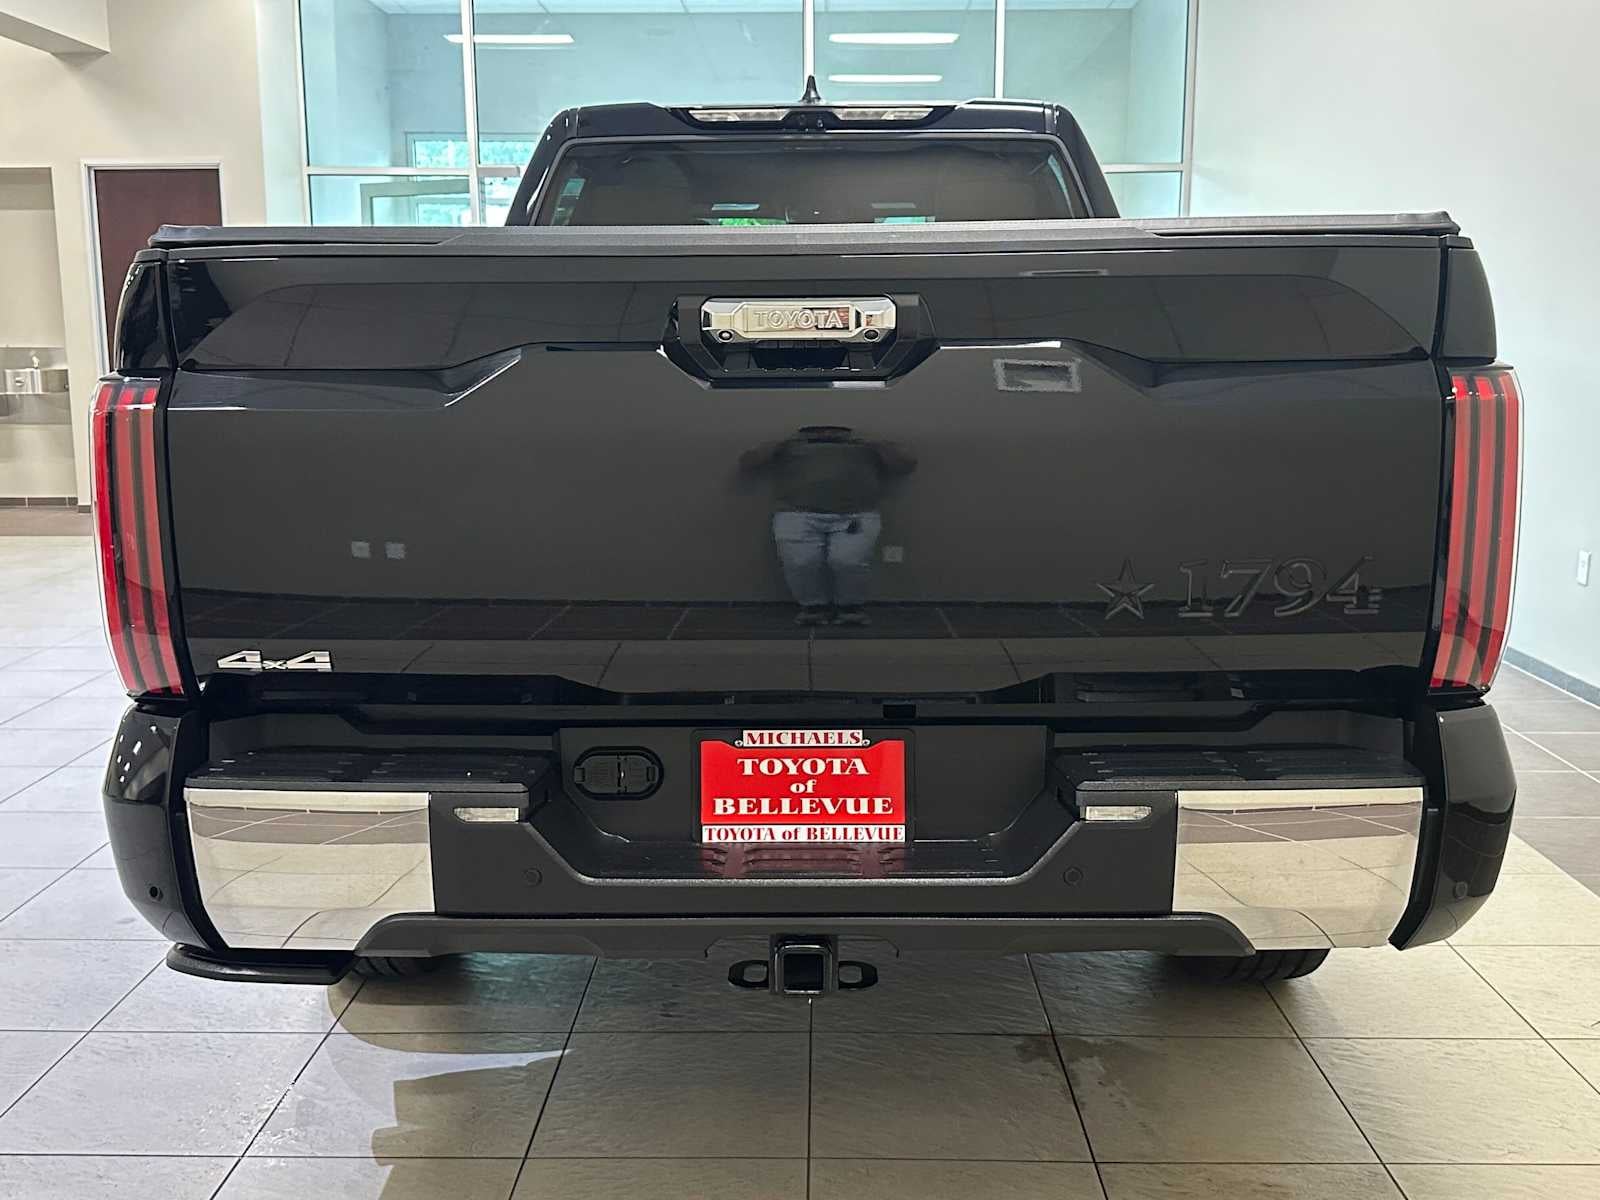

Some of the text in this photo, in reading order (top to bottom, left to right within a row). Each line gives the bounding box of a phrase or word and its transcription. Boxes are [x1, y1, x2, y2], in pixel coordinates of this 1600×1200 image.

[754, 310, 844, 329] TOYOTA
[1178, 555, 1383, 618] 1794
[746, 731, 861, 745] MICHAELS
[737, 758, 870, 776] TOYOTA
[789, 779, 818, 794] of
[713, 797, 894, 815] BELLEVUE
[704, 827, 905, 841] TOYOTA of BELLEVUE
